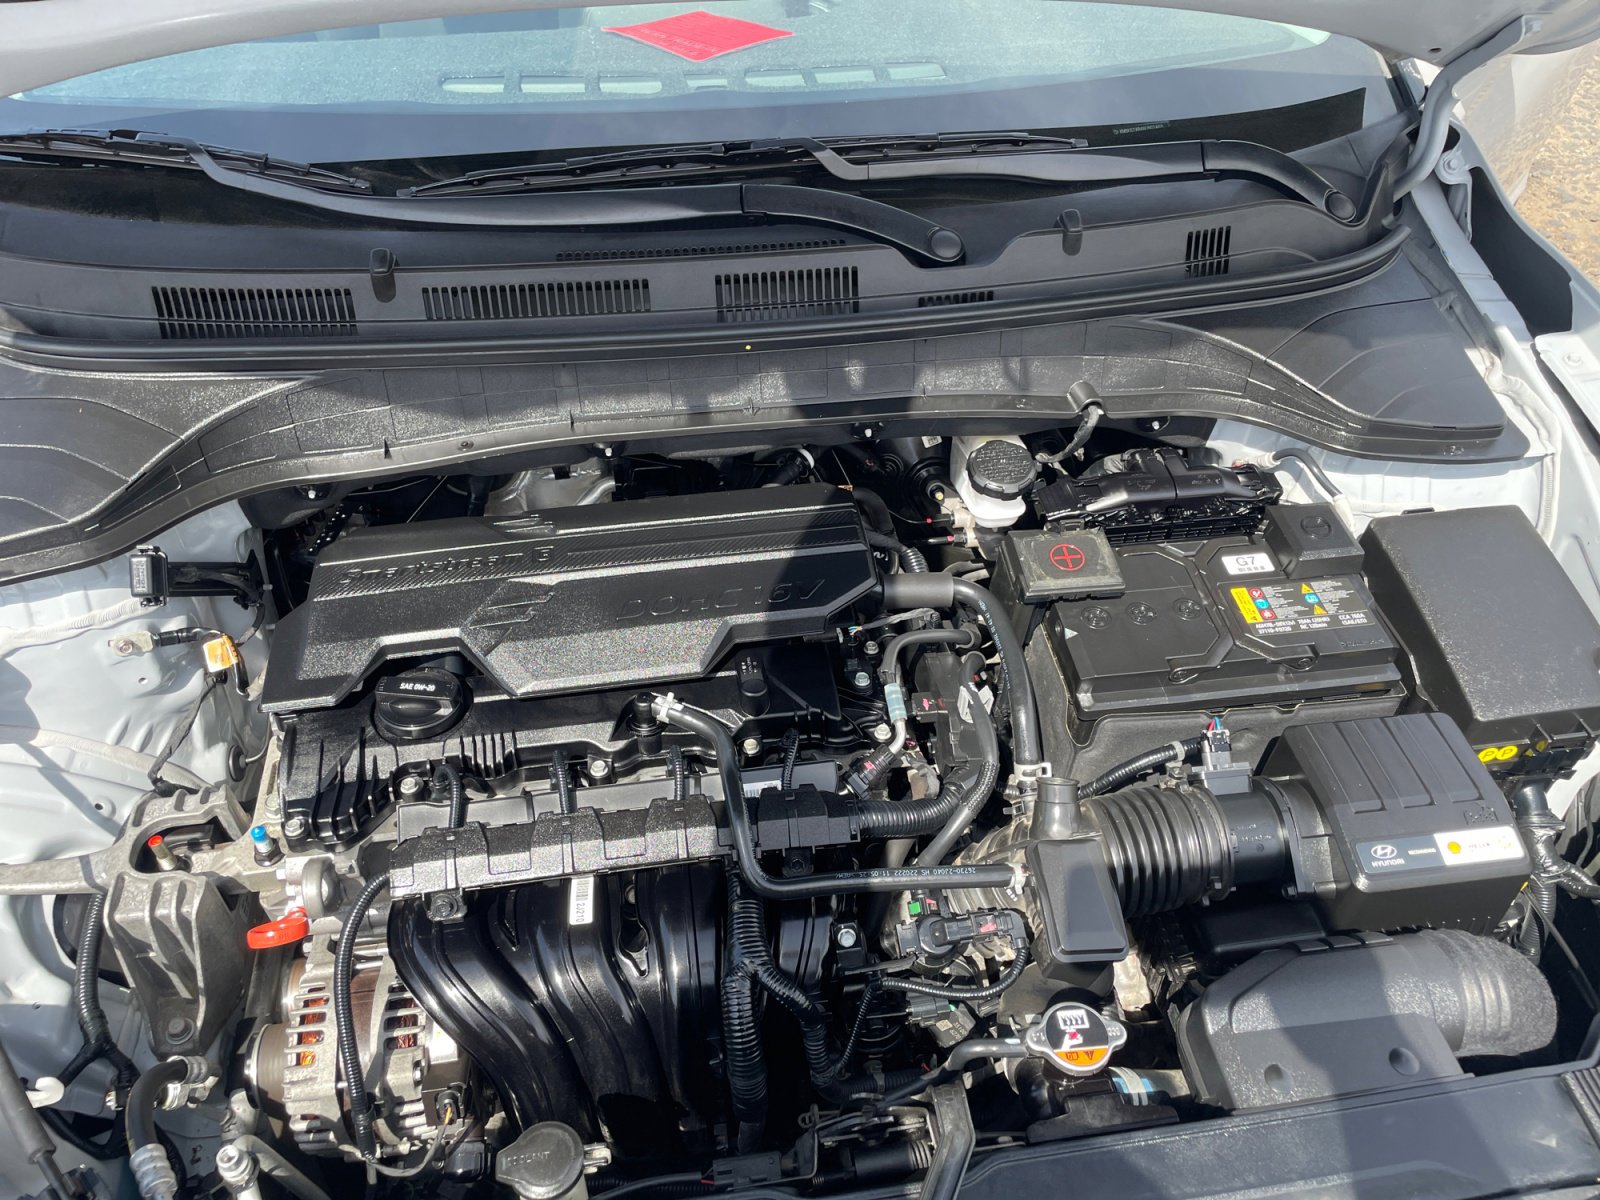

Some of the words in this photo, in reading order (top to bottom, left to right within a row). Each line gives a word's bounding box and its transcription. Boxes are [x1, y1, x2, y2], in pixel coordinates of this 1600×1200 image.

[1236, 556, 1255, 566] G7
[615, 588, 743, 621] DOHC
[753, 579, 825, 605] 16V
[400, 682, 414, 690] SAE
[414, 683, 436, 692] 0W-20
[1371, 858, 1405, 868] HYUNDAI
[507, 1151, 550, 1167] COOLANT
